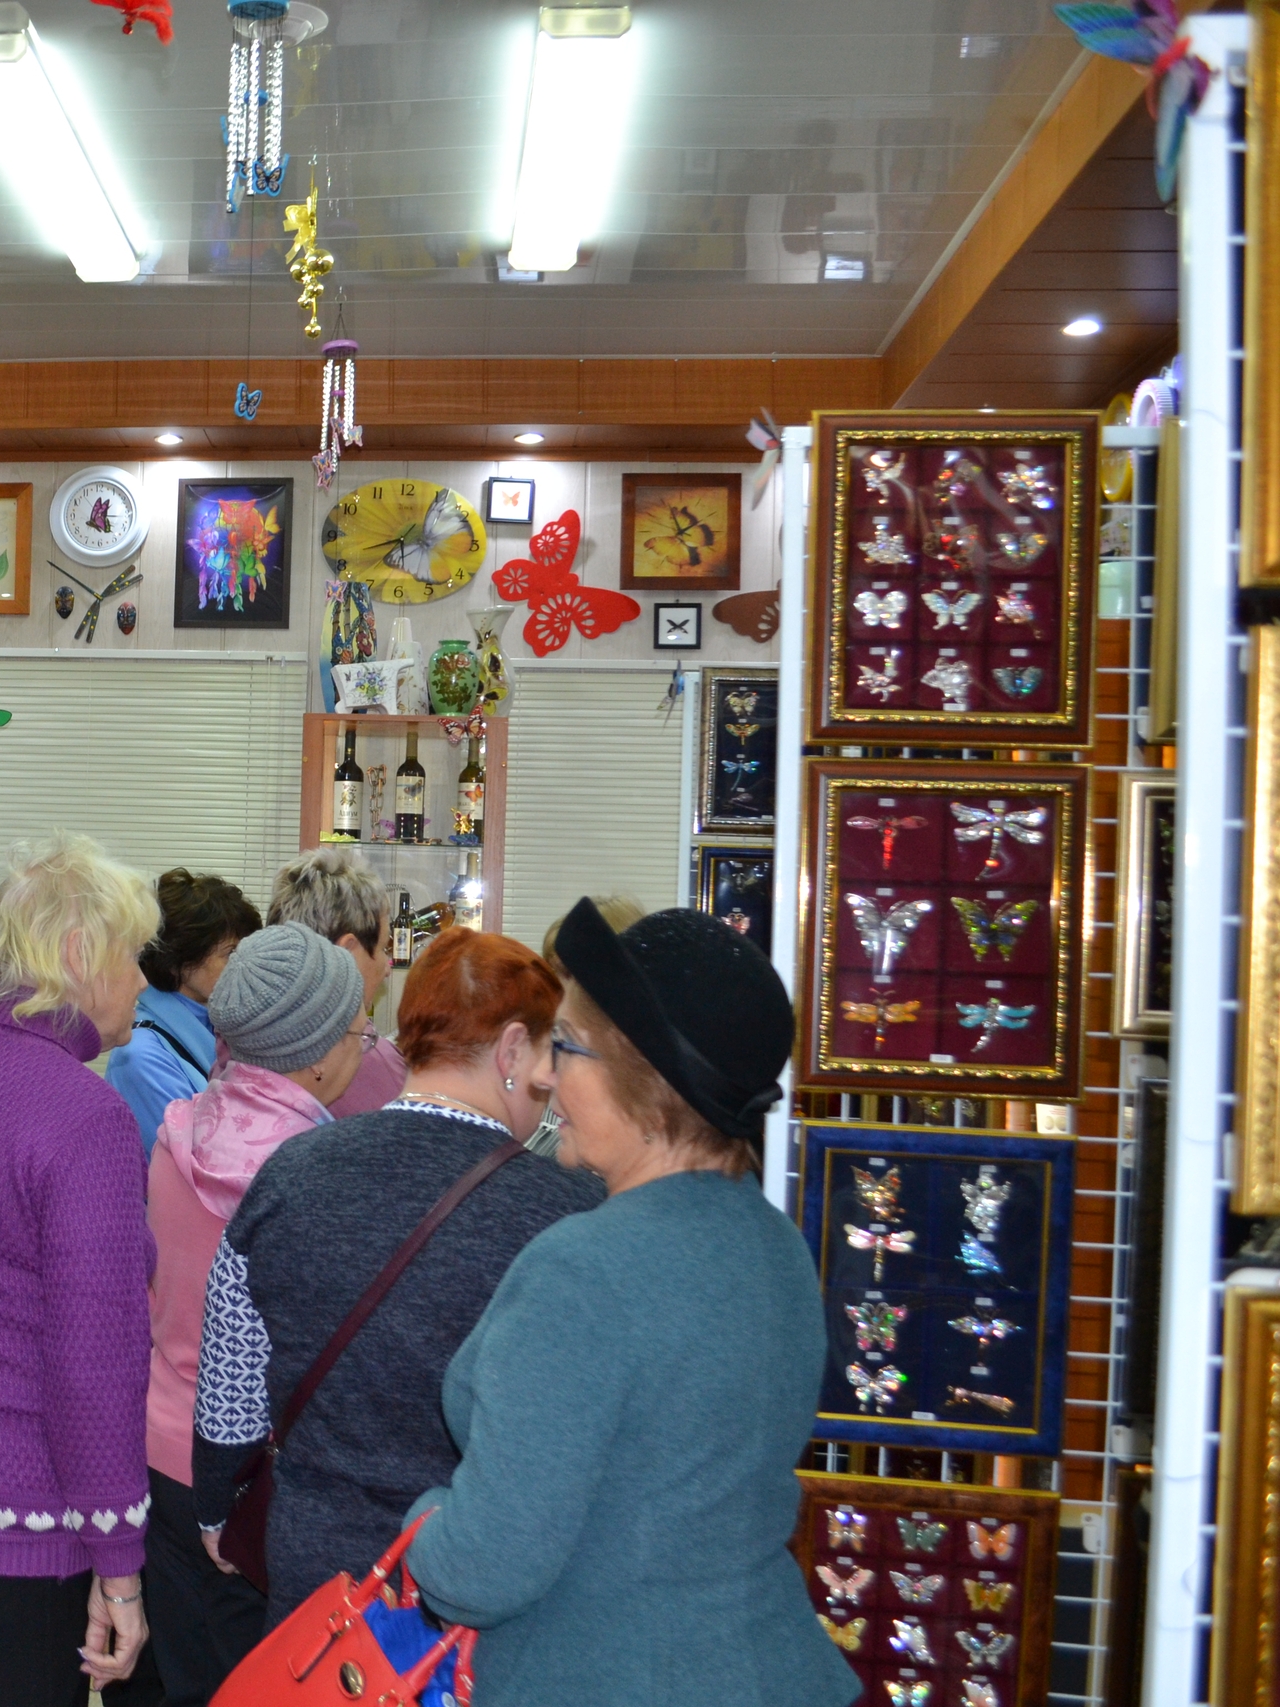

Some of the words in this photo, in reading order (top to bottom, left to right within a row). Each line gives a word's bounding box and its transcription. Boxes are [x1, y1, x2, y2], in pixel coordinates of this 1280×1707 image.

[83, 489, 89, 497] 11
[96, 484, 104, 493] 12
[373, 487, 383, 499] 11
[401, 484, 415, 496] 12
[435, 491, 439, 502] 1
[344, 503, 357, 515] 10
[70, 513, 76, 521] 9
[460, 511, 470, 522] 2
[74, 526, 80, 535] 8
[327, 530, 338, 542] 9
[84, 536, 89, 545] 7
[97, 538, 103, 547] 6
[469, 539, 480, 552] 3
[337, 559, 347, 572] 8
[455, 568, 465, 580] 4
[365, 579, 375, 591] 7
[424, 583, 434, 595] 5
[393, 586, 404, 598] 6
